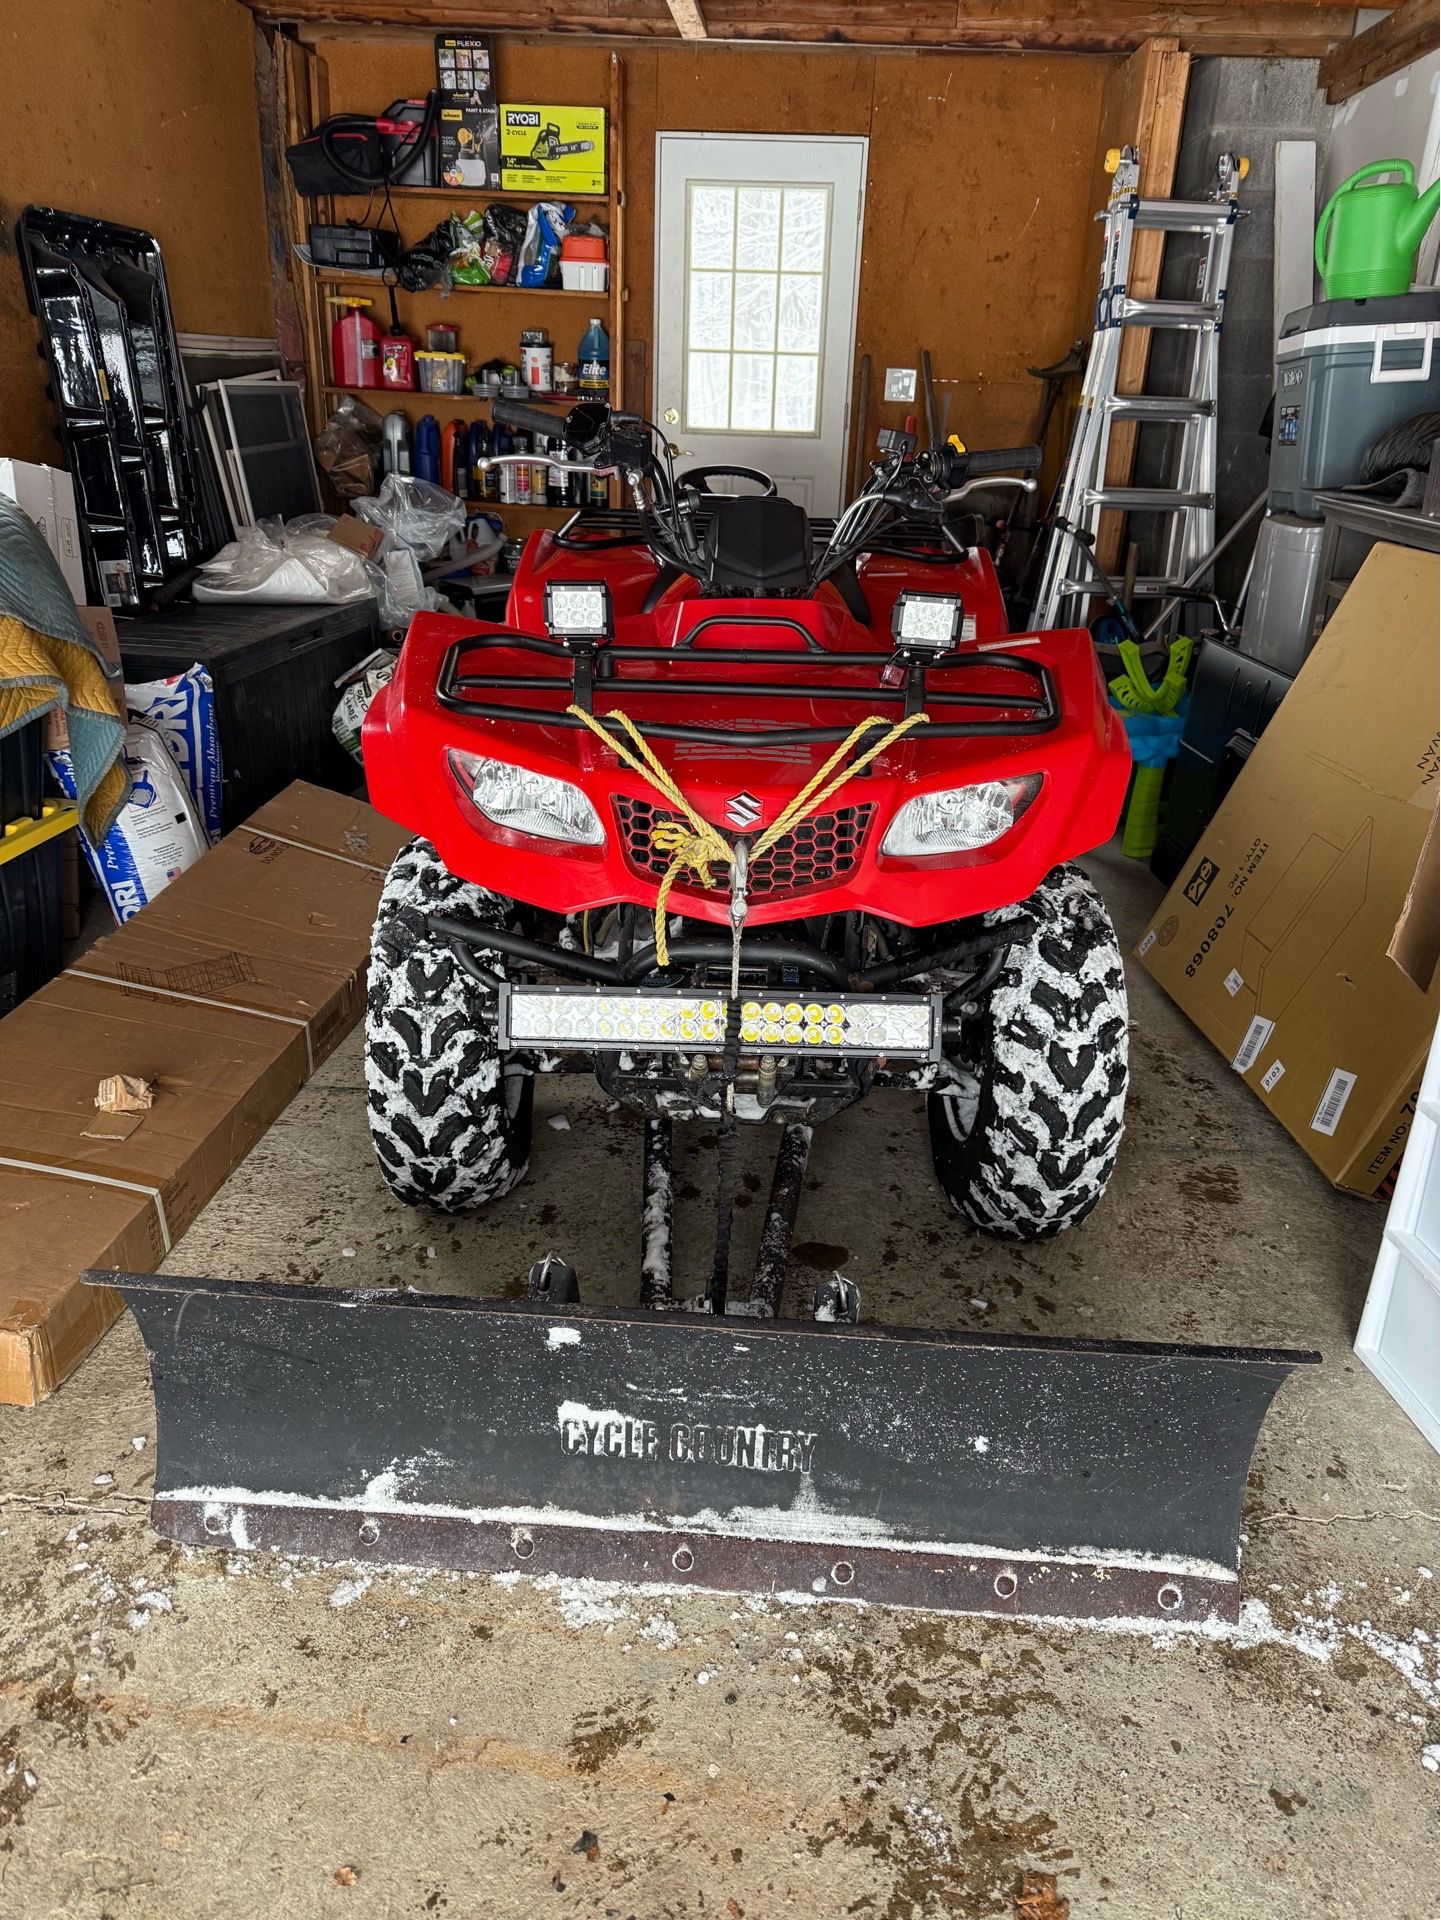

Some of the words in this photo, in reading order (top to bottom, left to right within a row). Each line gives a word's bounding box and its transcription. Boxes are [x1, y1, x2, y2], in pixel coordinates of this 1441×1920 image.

[506, 128, 527, 136] 2-CYCLE
[507, 112, 539, 125] RYOBI
[583, 362, 606, 375] Elite
[1247, 842, 1269, 874] ITEM
[1231, 876, 1249, 899] NO:
[1185, 904, 1235, 977] 708068
[1367, 1145, 1393, 1174] ITEM
[1389, 1122, 1411, 1144] NO:
[560, 1419, 658, 1461] CYCLE
[669, 1423, 818, 1472] COUNTRY
